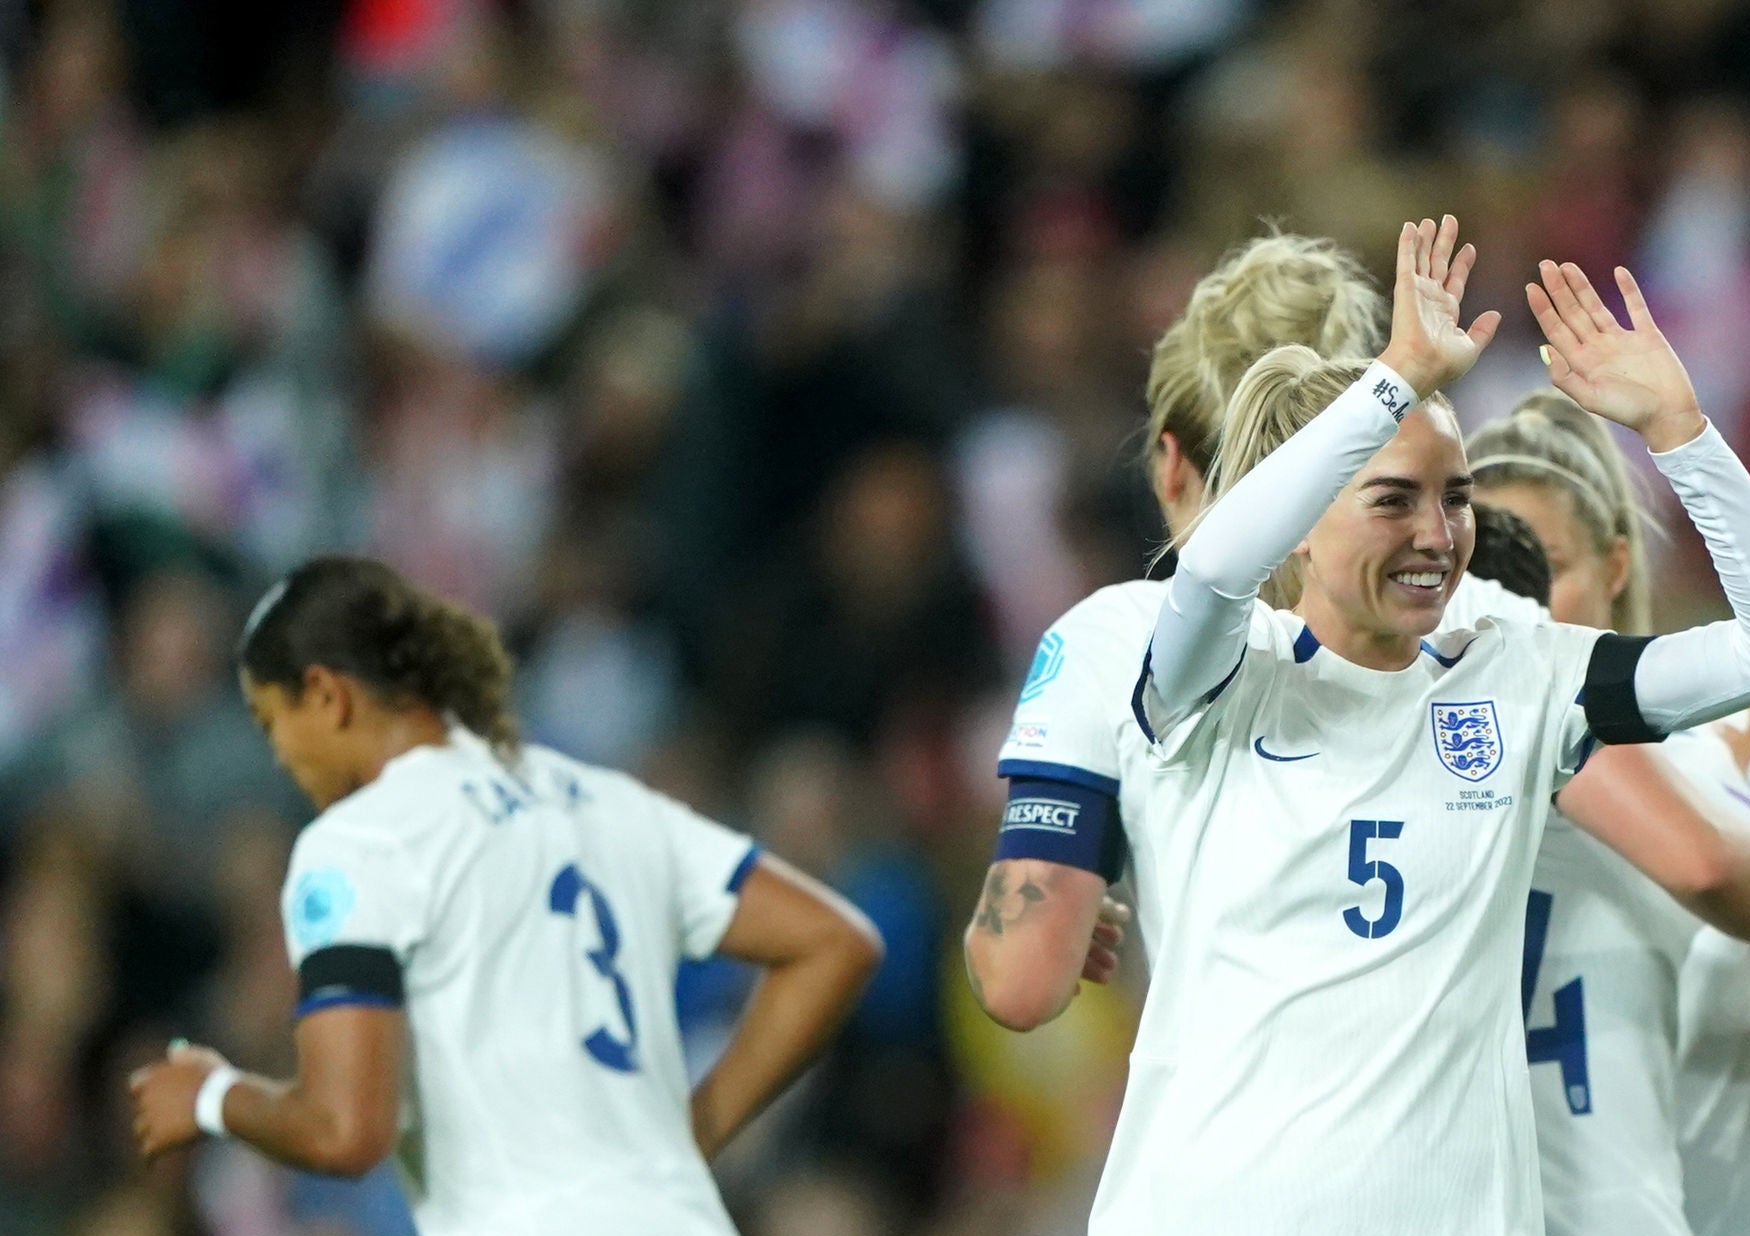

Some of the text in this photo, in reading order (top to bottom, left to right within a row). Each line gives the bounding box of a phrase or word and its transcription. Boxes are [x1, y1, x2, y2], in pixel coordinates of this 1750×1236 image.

[1456, 801, 1493, 811] SEPTEMBER
[1459, 789, 1495, 800] SCOTLAND
[1007, 803, 1080, 828] RESPECT
[1342, 819, 1405, 939] 5
[548, 864, 642, 1076] 3
